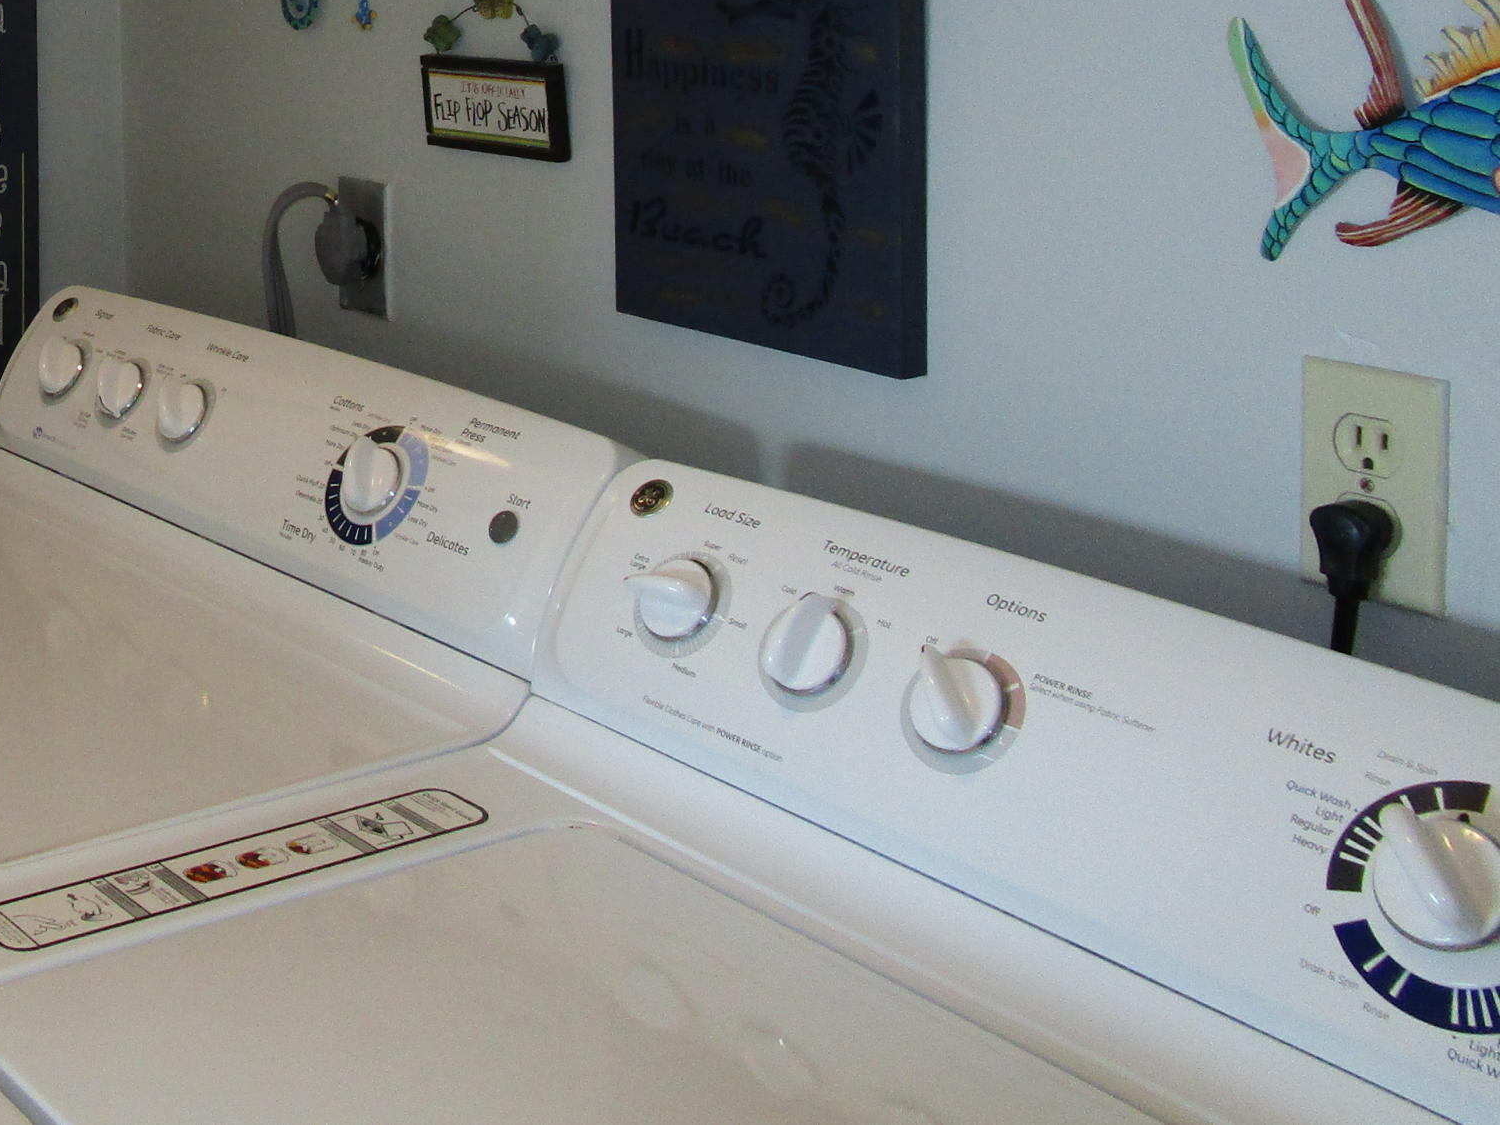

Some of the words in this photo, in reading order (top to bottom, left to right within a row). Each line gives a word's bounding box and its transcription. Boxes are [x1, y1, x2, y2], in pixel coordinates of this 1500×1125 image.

[624, 26, 780, 93] Happiness
[434, 93, 461, 124] FLIP
[465, 97, 493, 127] FLOP
[497, 102, 547, 134] SEASON
[718, 159, 753, 187] the
[629, 195, 767, 259] Beach
[231, 350, 250, 363] Care
[332, 395, 365, 412] Cottons
[460, 427, 487, 443] Press
[469, 417, 521, 441] Permanent
[506, 493, 532, 510] Start
[704, 502, 735, 521] Load
[735, 512, 762, 529] Size
[282, 518, 301, 536] Time
[301, 526, 317, 544] Dry
[426, 531, 470, 557] Delicates
[822, 539, 910, 578] Temperature
[986, 593, 1048, 624] Options
[1033, 673, 1067, 691] POWER
[1067, 684, 1093, 700] RINSE
[716, 727, 742, 745] POWER
[741, 738, 763, 754] RINSE
[1267, 727, 1337, 765] Whites
[1286, 780, 1317, 799] Quick
[1319, 790, 1351, 810] Wash
[1290, 813, 1334, 837] Regular
[1315, 806, 1345, 825] Light
[1292, 834, 1329, 855] Heavy
[1446, 1047, 1483, 1073] Quick
